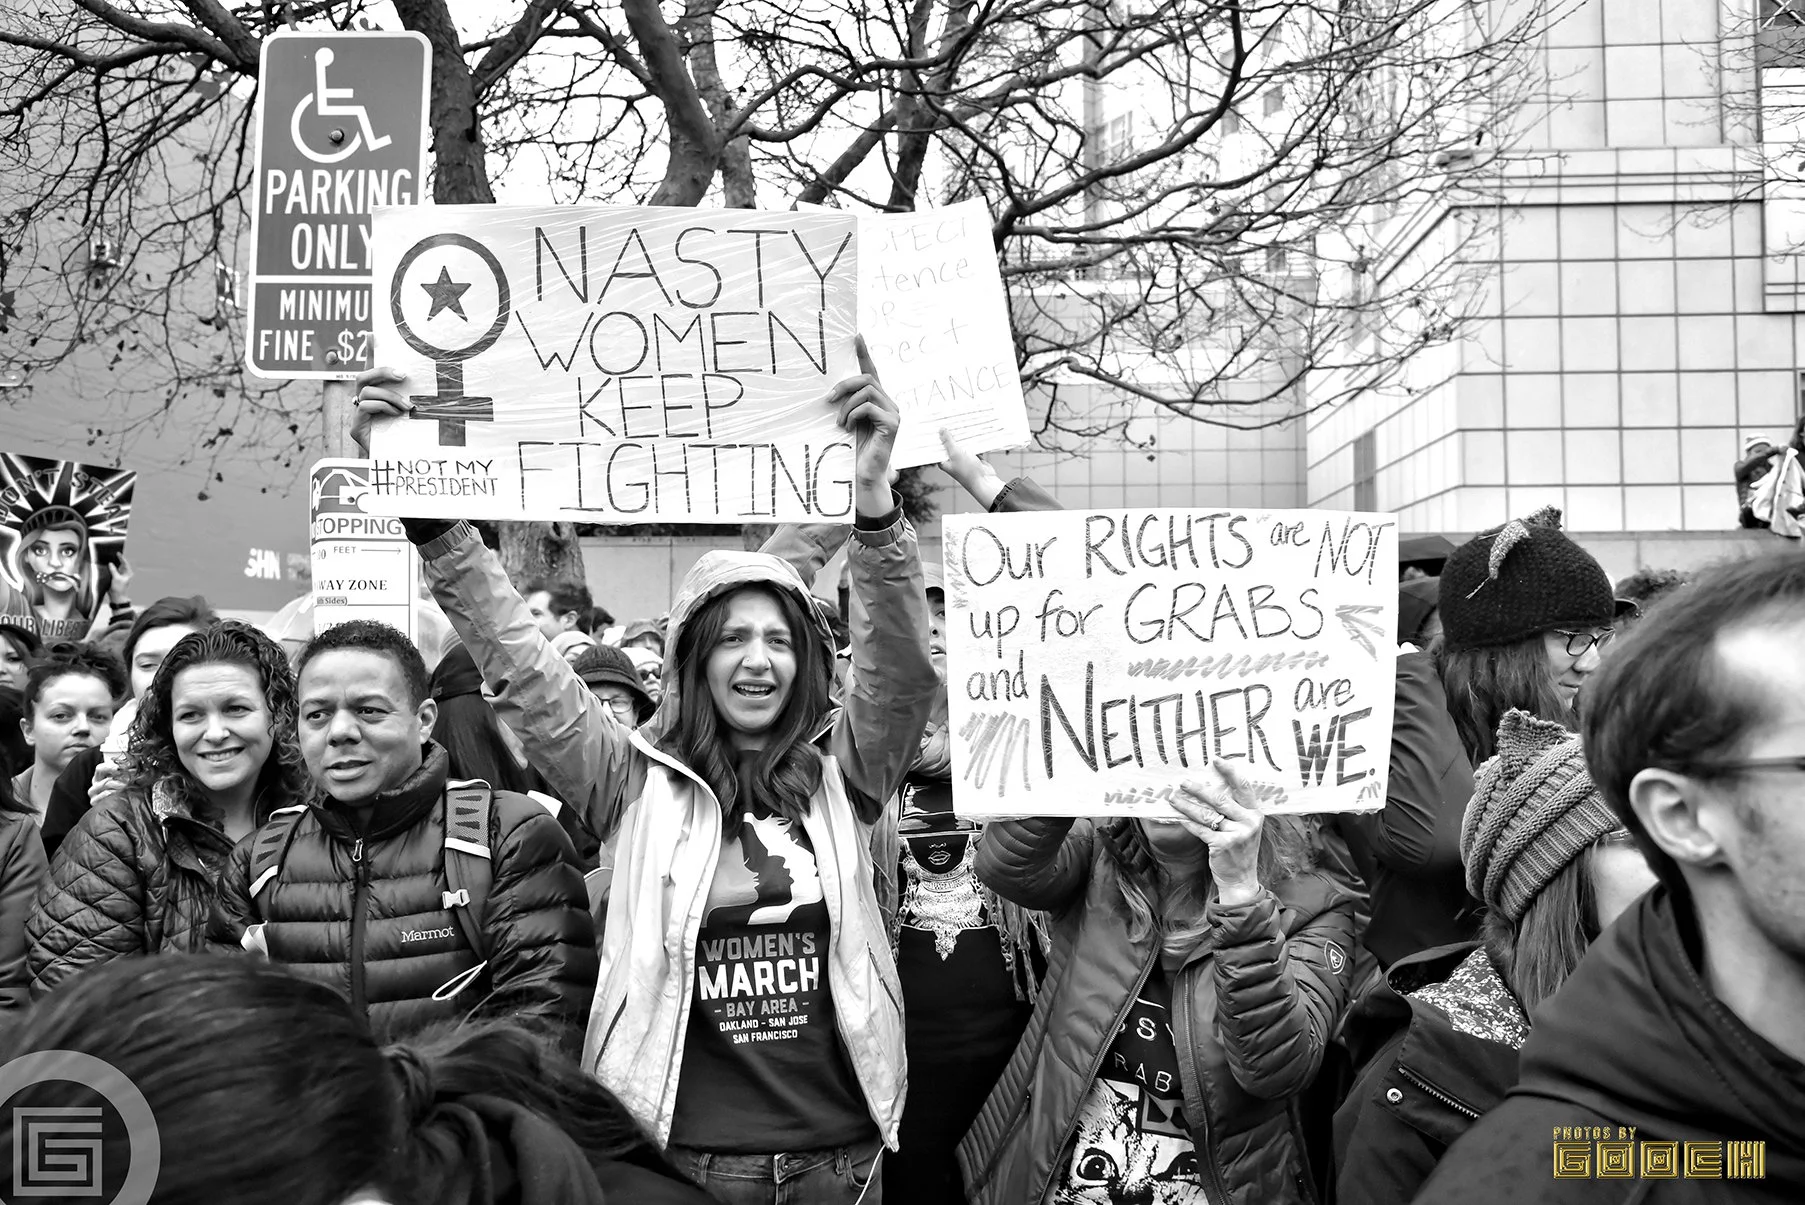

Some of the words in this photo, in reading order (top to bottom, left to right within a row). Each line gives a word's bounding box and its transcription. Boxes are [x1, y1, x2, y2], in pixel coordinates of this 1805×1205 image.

[266, 169, 412, 214] PARKING
[291, 222, 373, 269] ONLY
[535, 226, 852, 310] NASTY
[871, 257, 975, 292] tence
[259, 329, 315, 361] FINE
[516, 310, 827, 375] WOMEN
[578, 374, 744, 438] KEEP
[456, 460, 493, 475] MY
[518, 441, 853, 517] FIGHTING
[333, 546, 356, 554] FEET
[963, 526, 1057, 586] Our
[1085, 513, 1253, 579] RIGHTS
[1270, 521, 1310, 547] are
[1314, 517, 1394, 585] NOT
[348, 580, 388, 591] ZONE
[970, 605, 1020, 658] up
[1035, 589, 1103, 642] for
[1124, 583, 1324, 644] GRABS
[966, 650, 1029, 702] and
[1040, 661, 1282, 779] NEITHER
[1294, 677, 1355, 713] are
[1292, 707, 1376, 787] WE.
[401, 926, 455, 943] Marmot
[701, 932, 816, 961] WOMEN'S
[698, 957, 820, 1000] MARCH
[719, 1019, 759, 1032] OAKLAND
[768, 1016, 786, 1028] SAN
[788, 1014, 809, 1026] JOSE
[726, 1002, 755, 1018] BAY
[760, 997, 799, 1015] AREA
[733, 1031, 749, 1044] SAN
[751, 1029, 798, 1042] FRANCISCO
